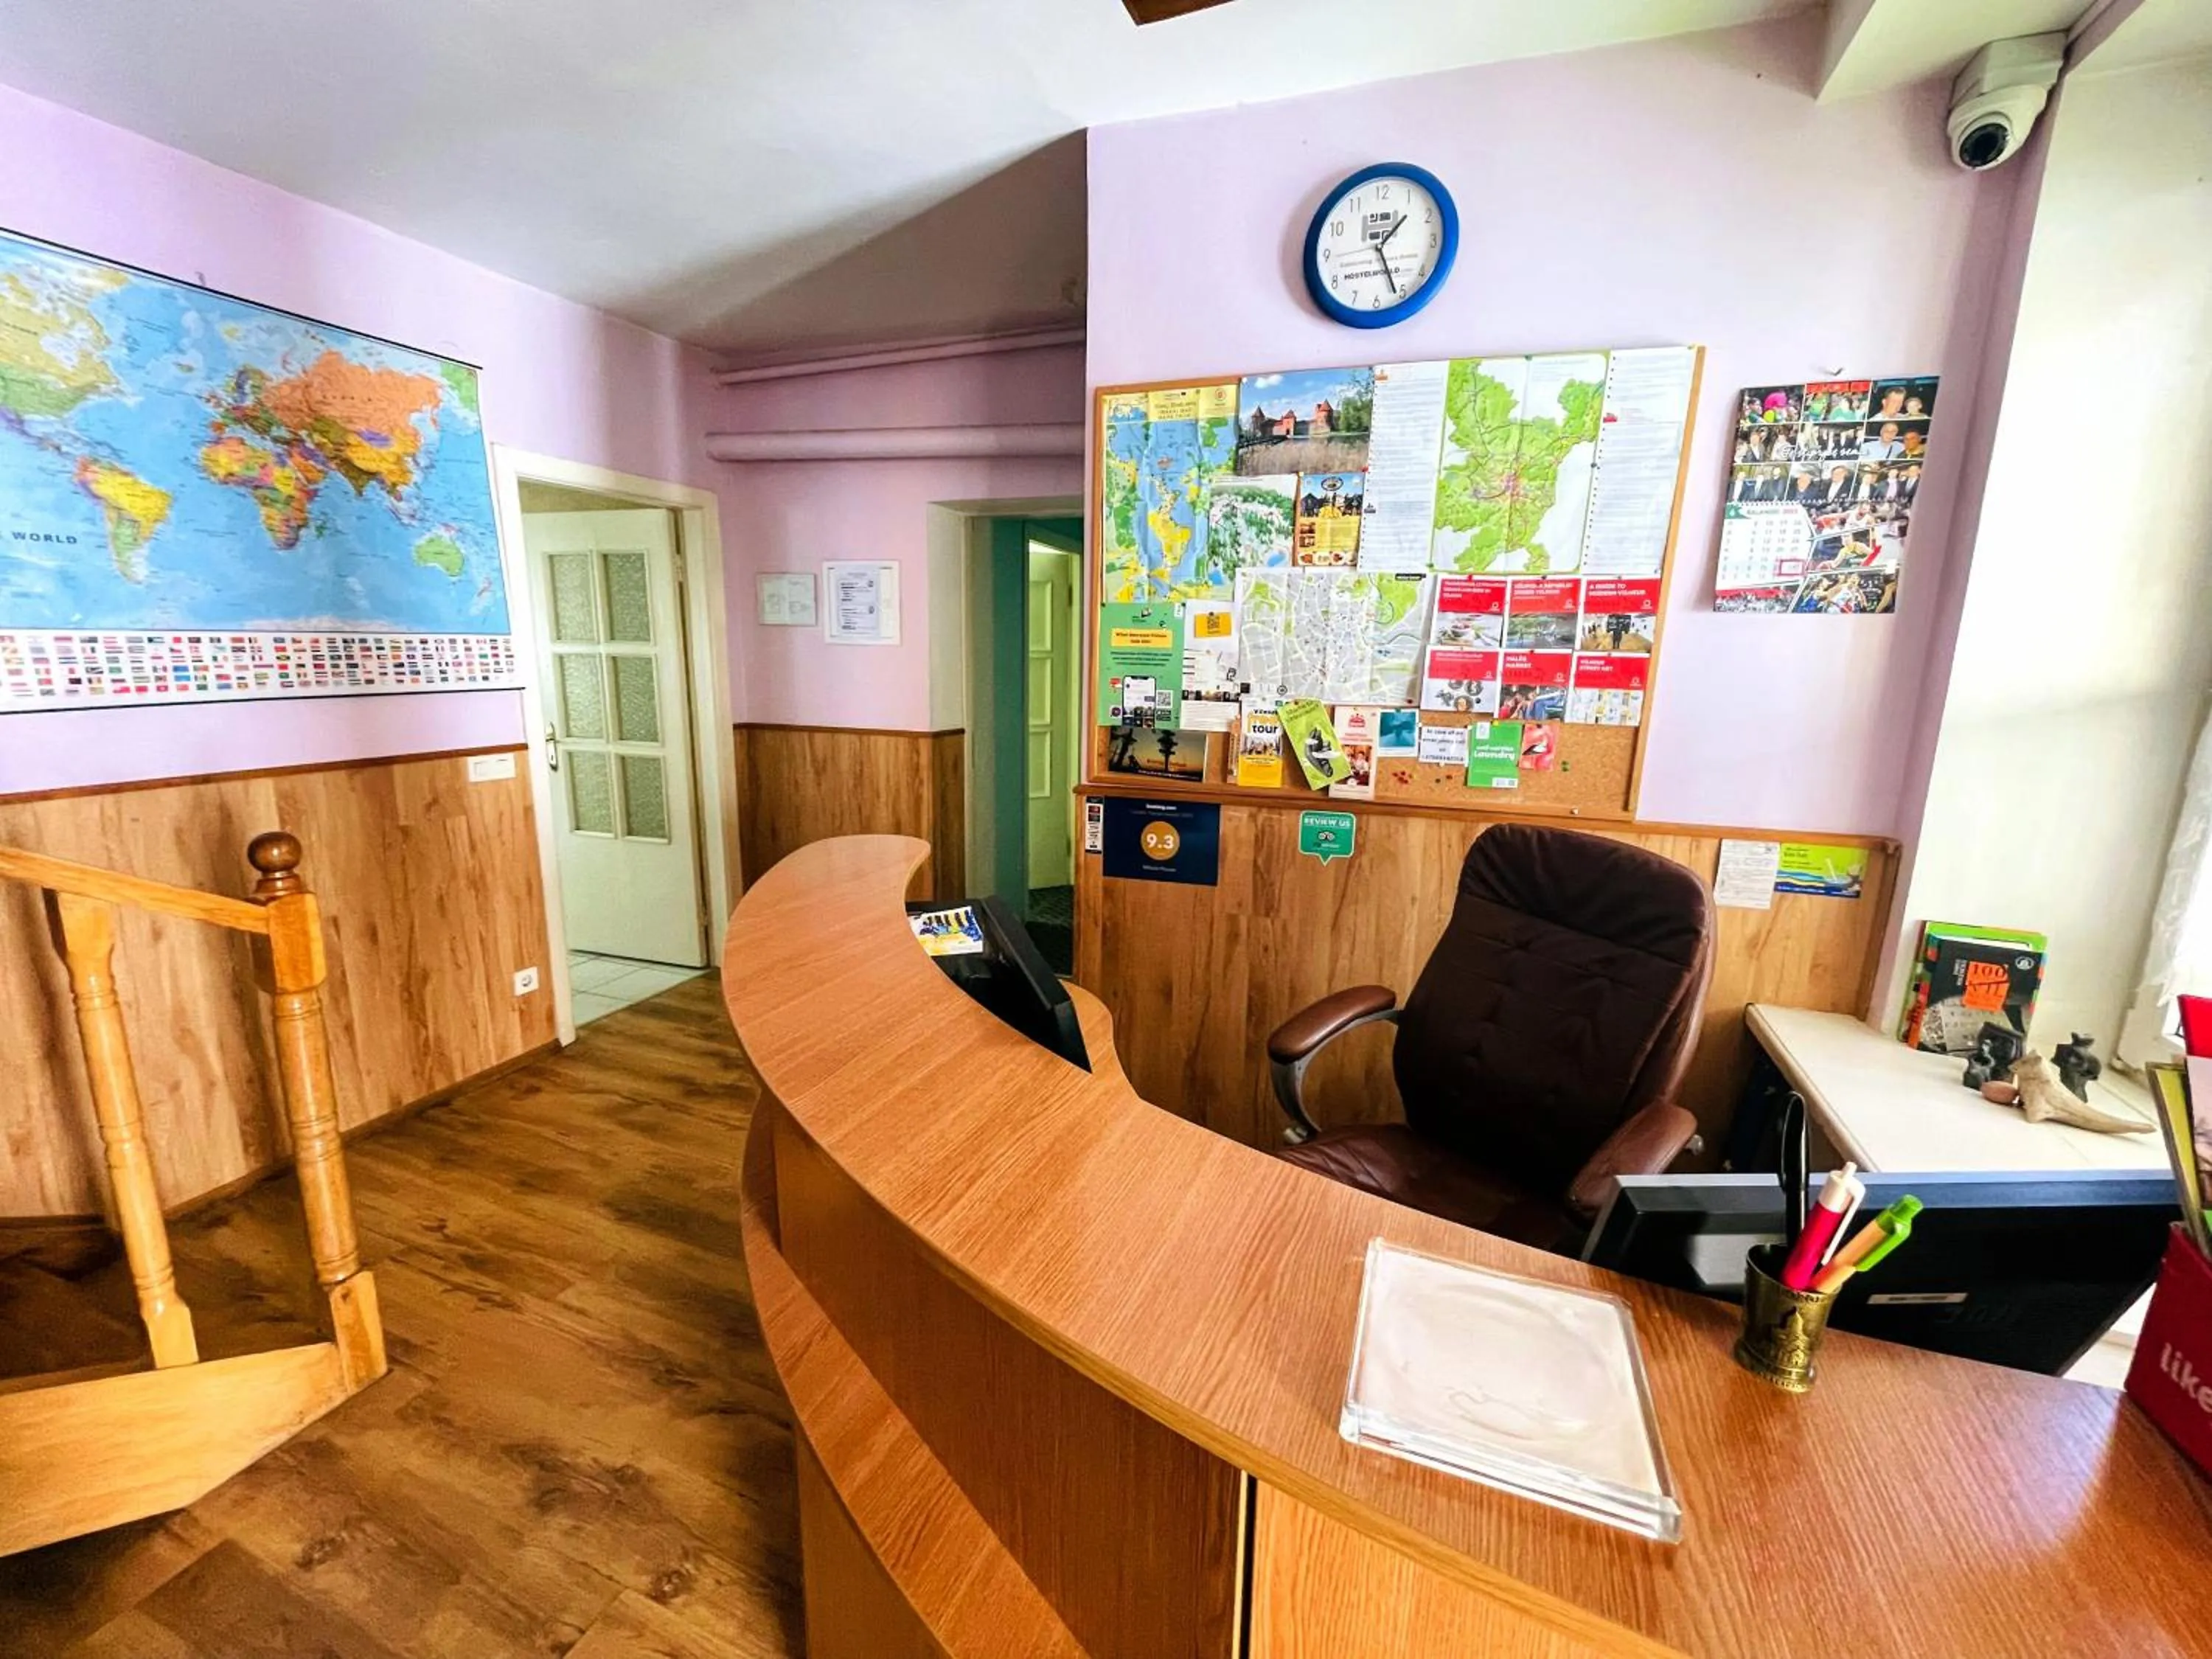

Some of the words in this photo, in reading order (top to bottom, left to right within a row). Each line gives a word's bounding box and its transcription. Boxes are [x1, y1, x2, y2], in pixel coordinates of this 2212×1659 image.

[1376, 184, 1391, 200] 12
[1406, 189, 1411, 204] 1
[1349, 196, 1361, 213] 11
[1425, 208, 1433, 223] 2
[1329, 220, 1344, 237] 10
[1429, 233, 1437, 248] 3
[1323, 248, 1331, 263] 9
[1344, 266, 1400, 280] HOSTELWOLD
[1418, 263, 1425, 278] 4
[1331, 274, 1338, 290] 8
[1352, 290, 1358, 305] 7
[1399, 284, 1407, 299] 5
[1372, 295, 1381, 310] 6
[10, 530, 77, 544] WORLD
[1252, 725, 1279, 734] tour
[1146, 833, 1175, 849] 9.3
